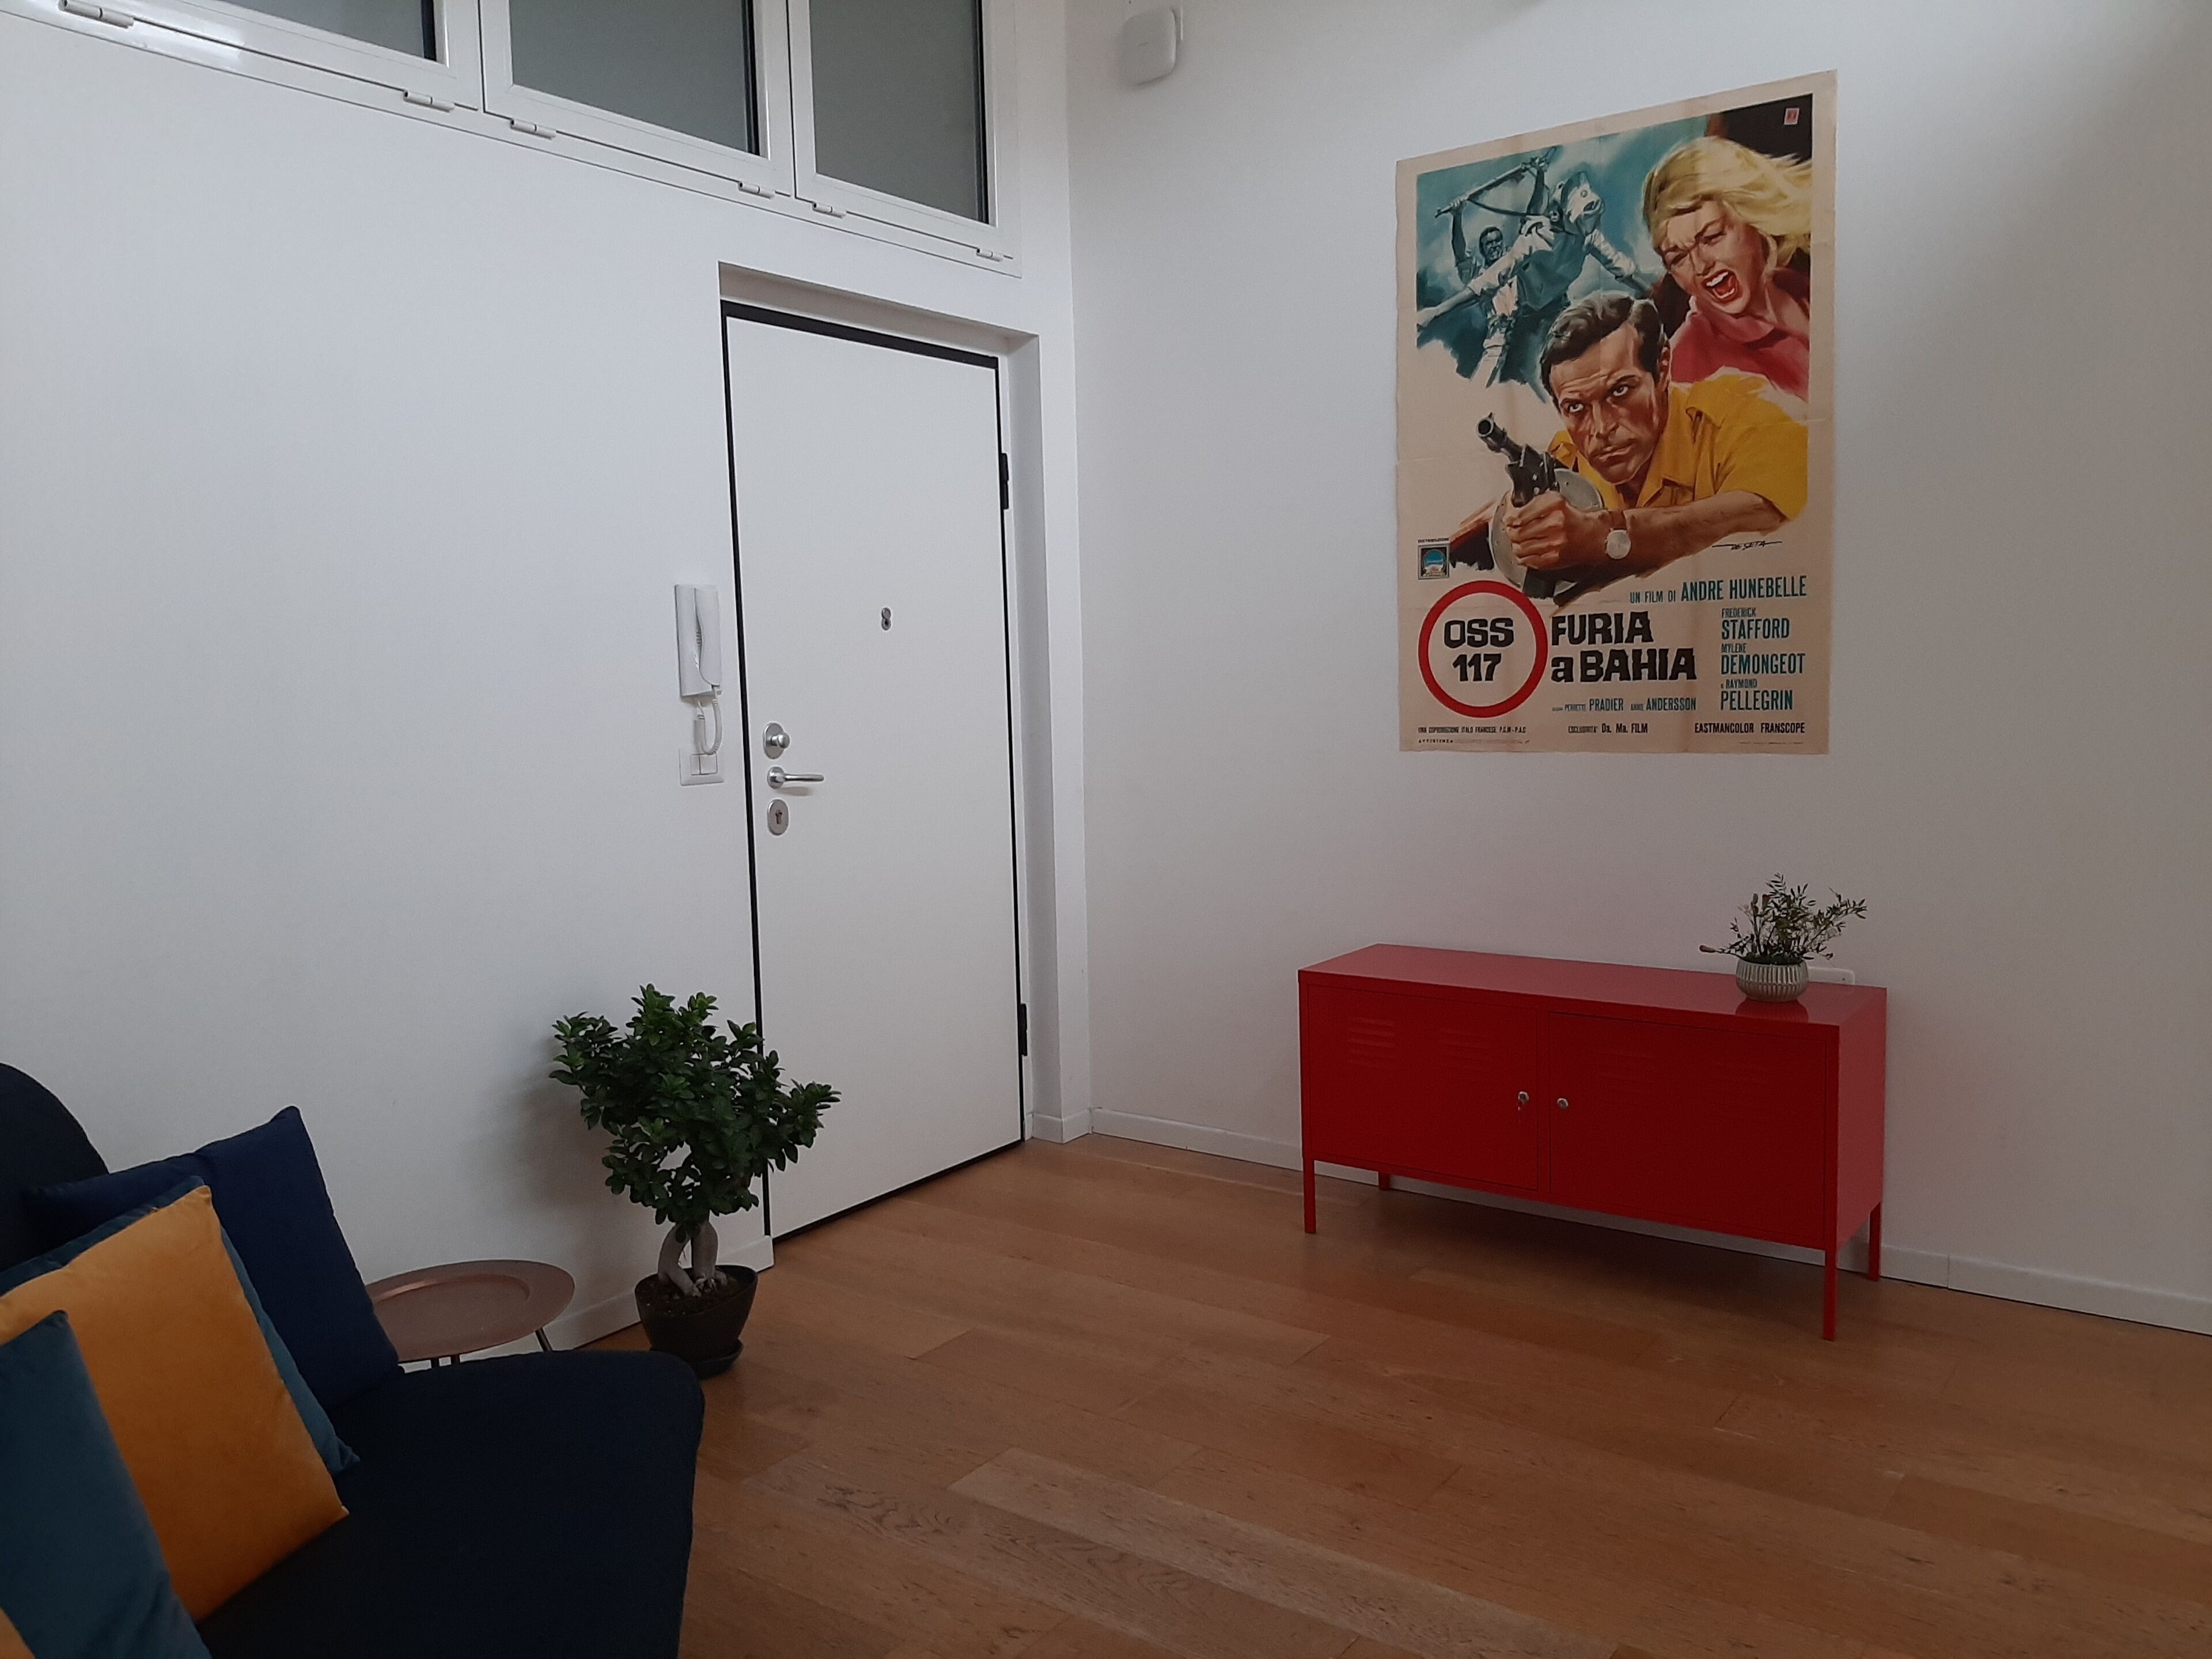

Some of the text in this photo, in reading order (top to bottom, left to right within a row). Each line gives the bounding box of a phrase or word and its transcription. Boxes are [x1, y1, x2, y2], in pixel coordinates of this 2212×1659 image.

[1630, 575, 1807, 603] UN FILM DI ANDRE HUNEBELLE
[1444, 618, 1514, 649] OSS
[1551, 611, 1654, 646] FURIA
[1721, 618, 1790, 639] STAFFORD
[1721, 643, 1747, 653] MYLENE
[1452, 653, 1502, 682] 117
[1580, 647, 1697, 683] BAHIA
[1721, 653, 1806, 675] DEMONGEOT
[1726, 679, 1758, 689] RAYMOND
[1589, 698, 1624, 711] PRADIER
[1646, 698, 1696, 711] ANDERSSON
[1720, 690, 1793, 711] PELLEGRIN
[1601, 723, 1612, 733] Da.
[1616, 724, 1628, 733] Ma.
[1631, 723, 1649, 733] FILM
[1695, 722, 1805, 733] EASTMANCOLOR FRANSCOPE
